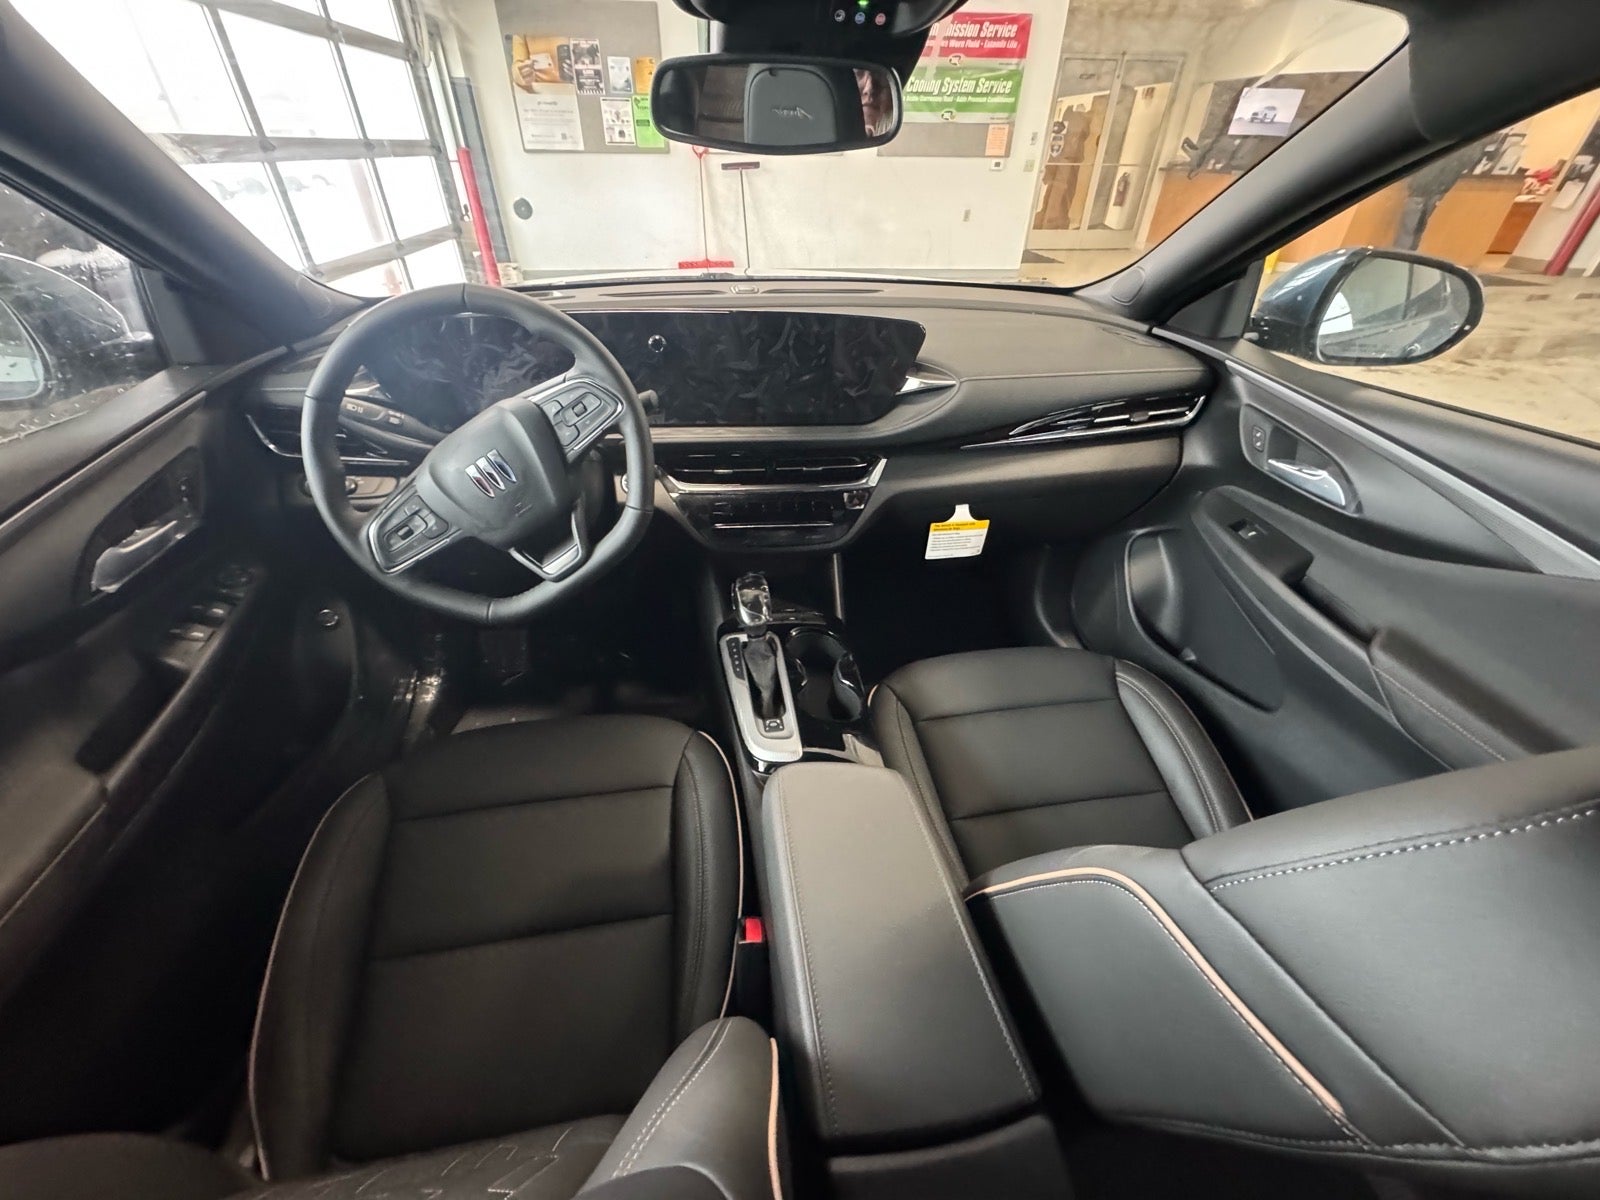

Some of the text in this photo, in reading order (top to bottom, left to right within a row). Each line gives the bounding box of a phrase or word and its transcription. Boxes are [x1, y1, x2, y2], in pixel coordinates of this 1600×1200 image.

[980, 22, 1017, 38] Service
[906, 77, 1012, 95] Cooling System Service
